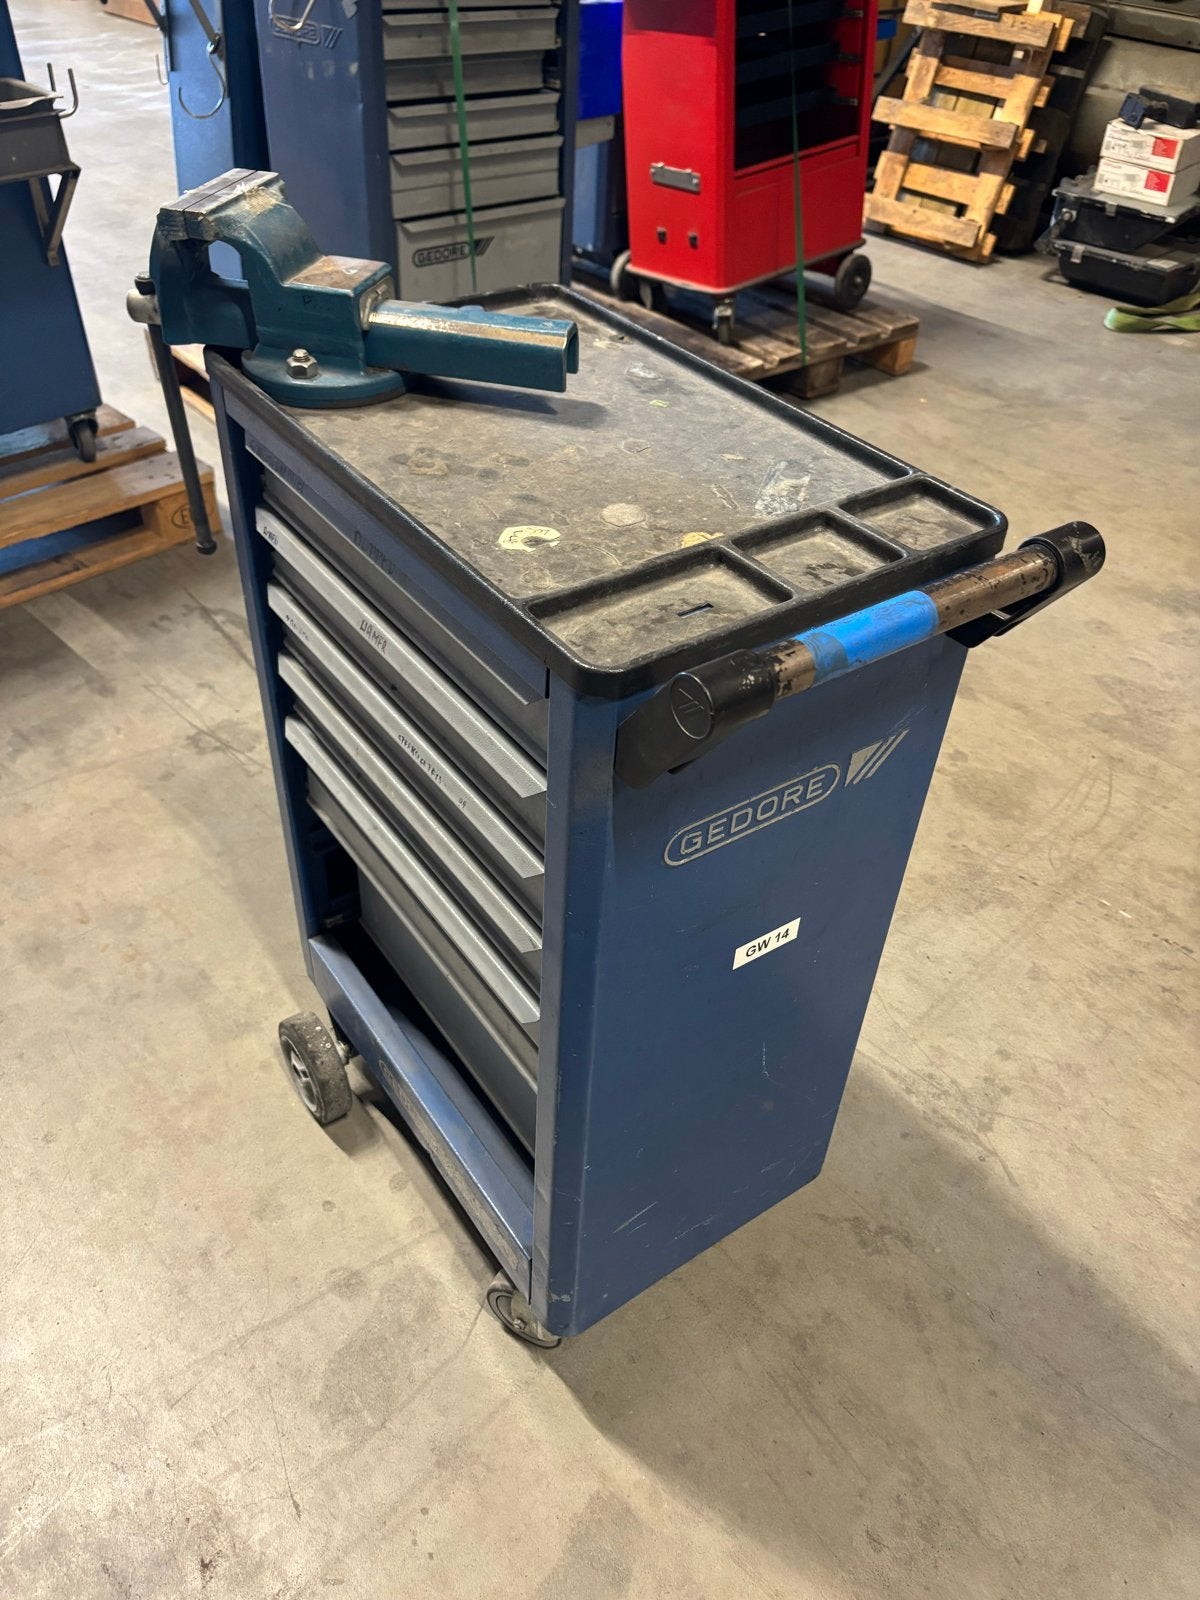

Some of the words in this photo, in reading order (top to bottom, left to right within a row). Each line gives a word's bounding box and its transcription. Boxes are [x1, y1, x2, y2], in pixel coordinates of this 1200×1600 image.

[417, 243, 468, 264] GEDORE
[679, 774, 826, 856] GEDORE
[745, 937, 772, 959] GW
[775, 928, 790, 945] 14
